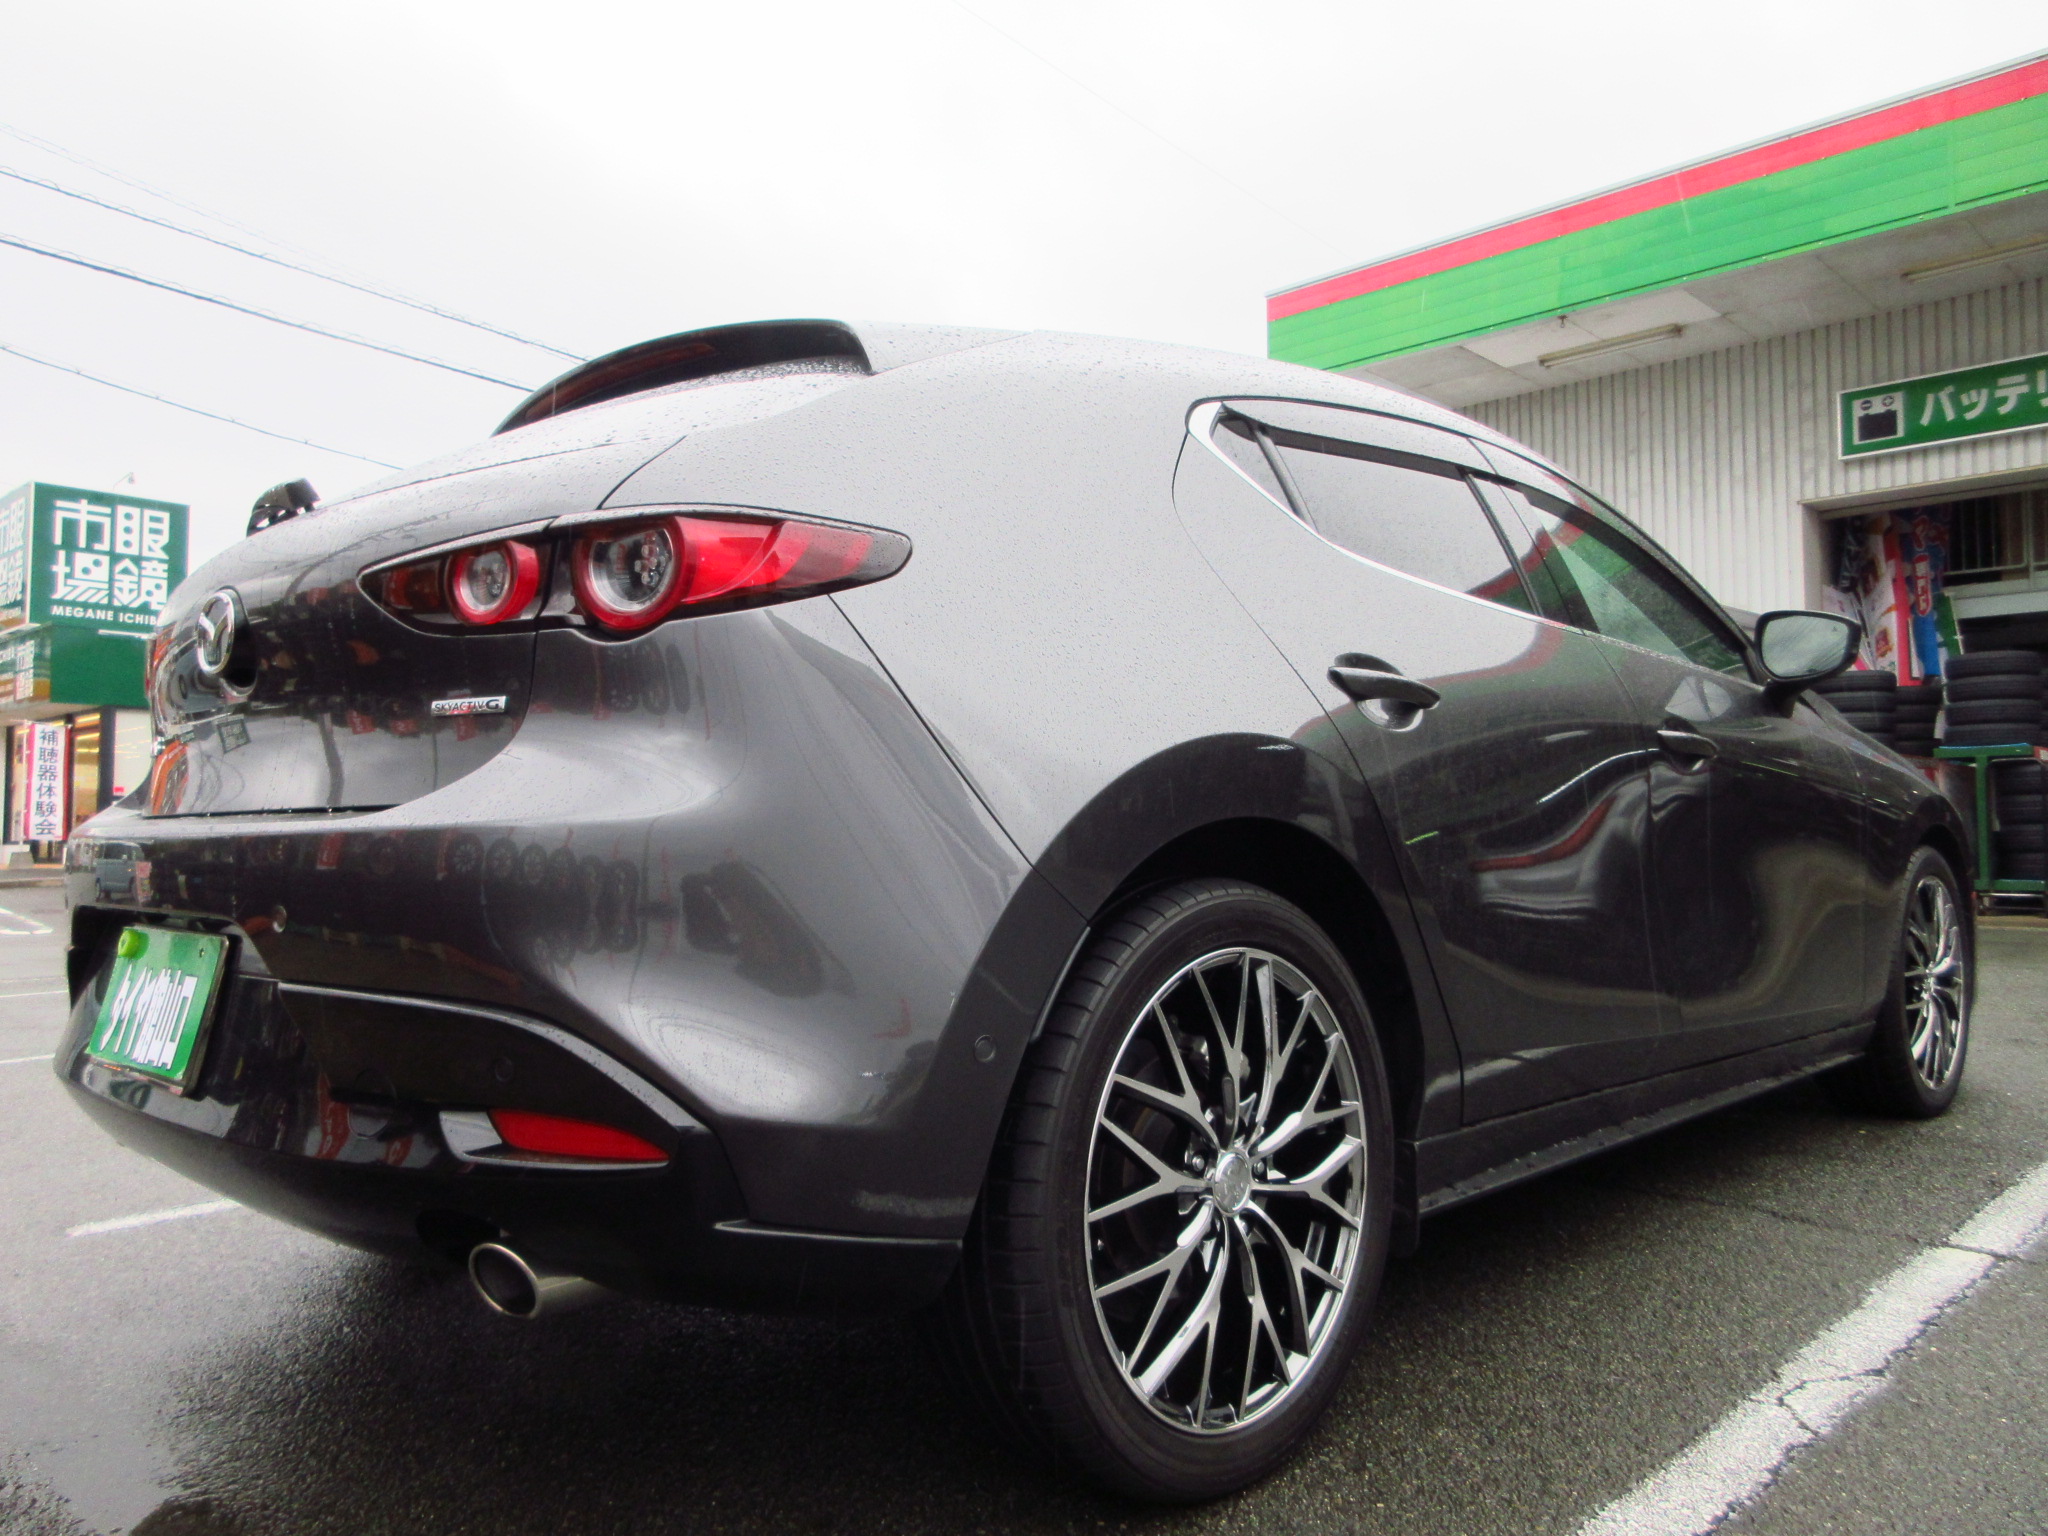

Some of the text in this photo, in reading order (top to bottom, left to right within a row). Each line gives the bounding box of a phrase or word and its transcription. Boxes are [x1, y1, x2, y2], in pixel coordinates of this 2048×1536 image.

[51, 606, 115, 621] MEGANE
[35, 728, 59, 836] 補聴器体験会
